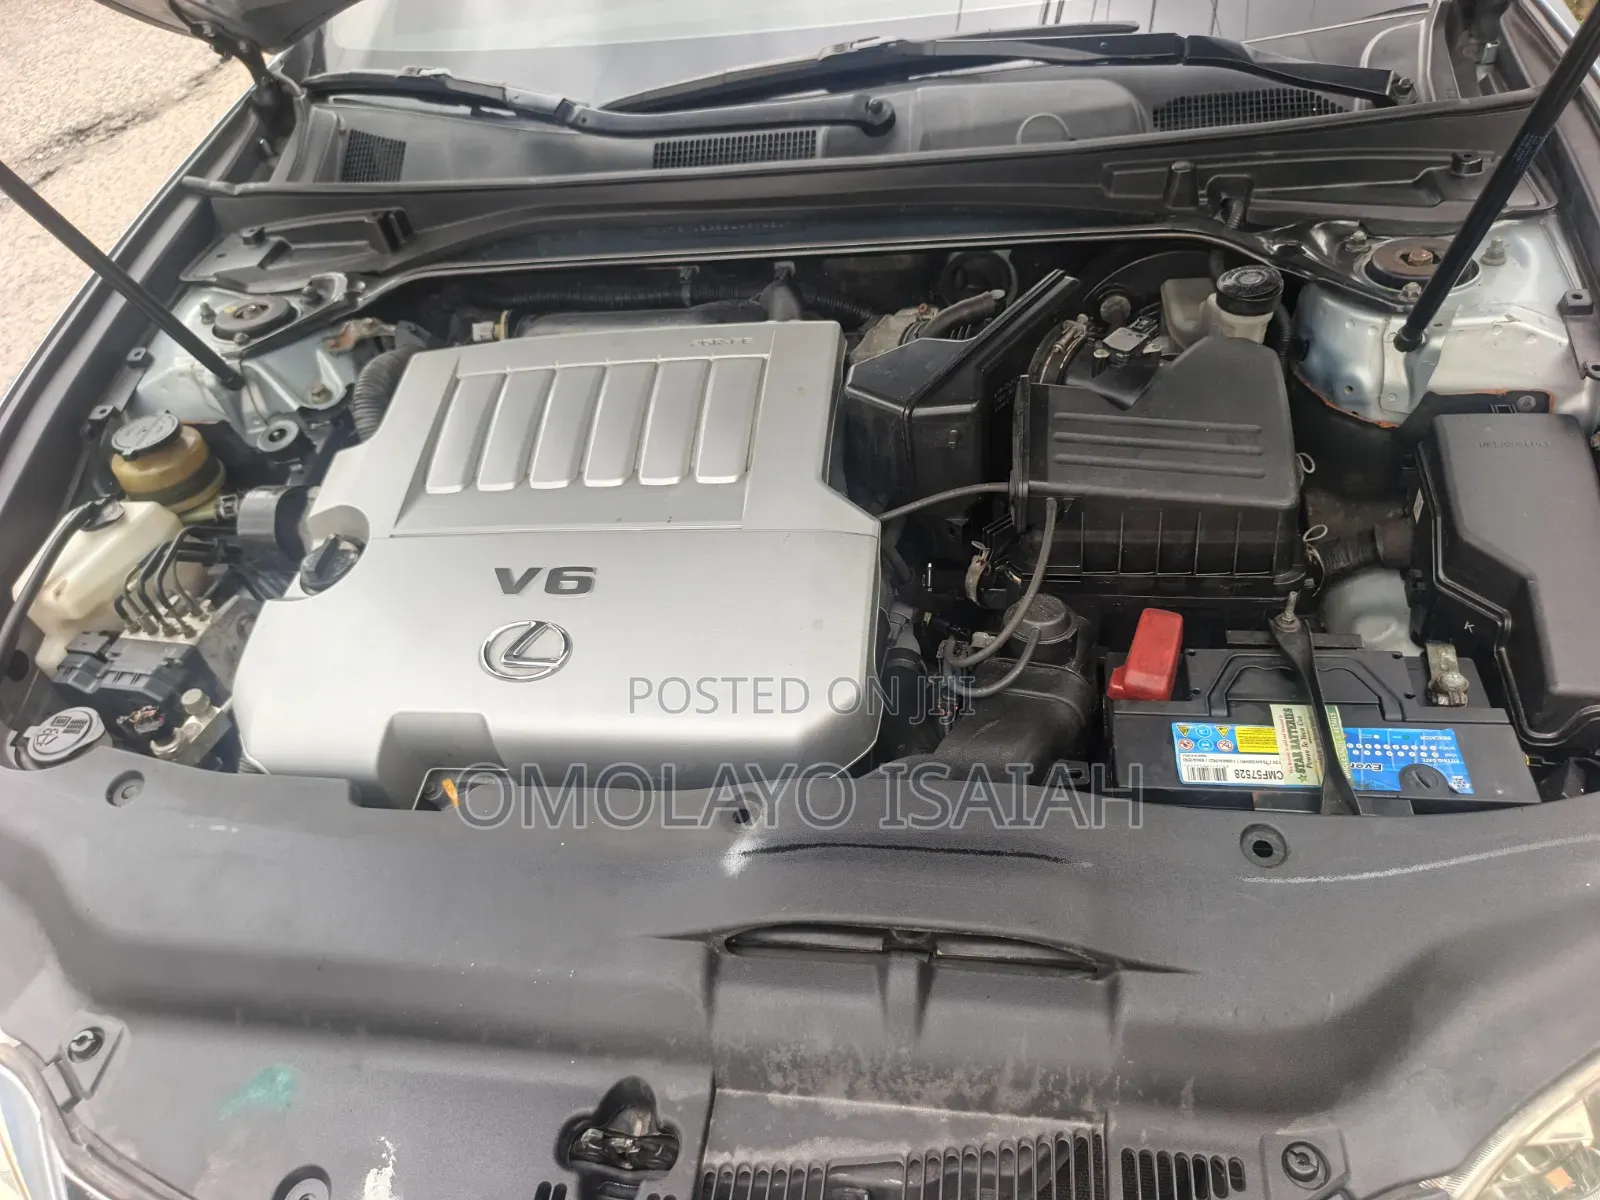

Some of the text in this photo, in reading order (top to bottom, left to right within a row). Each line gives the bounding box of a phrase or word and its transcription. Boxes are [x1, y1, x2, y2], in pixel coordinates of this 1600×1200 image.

[494, 566, 598, 597] V6
[1283, 707, 1306, 774] STAR BATTERIES
[1234, 768, 1284, 780] CMF57528
